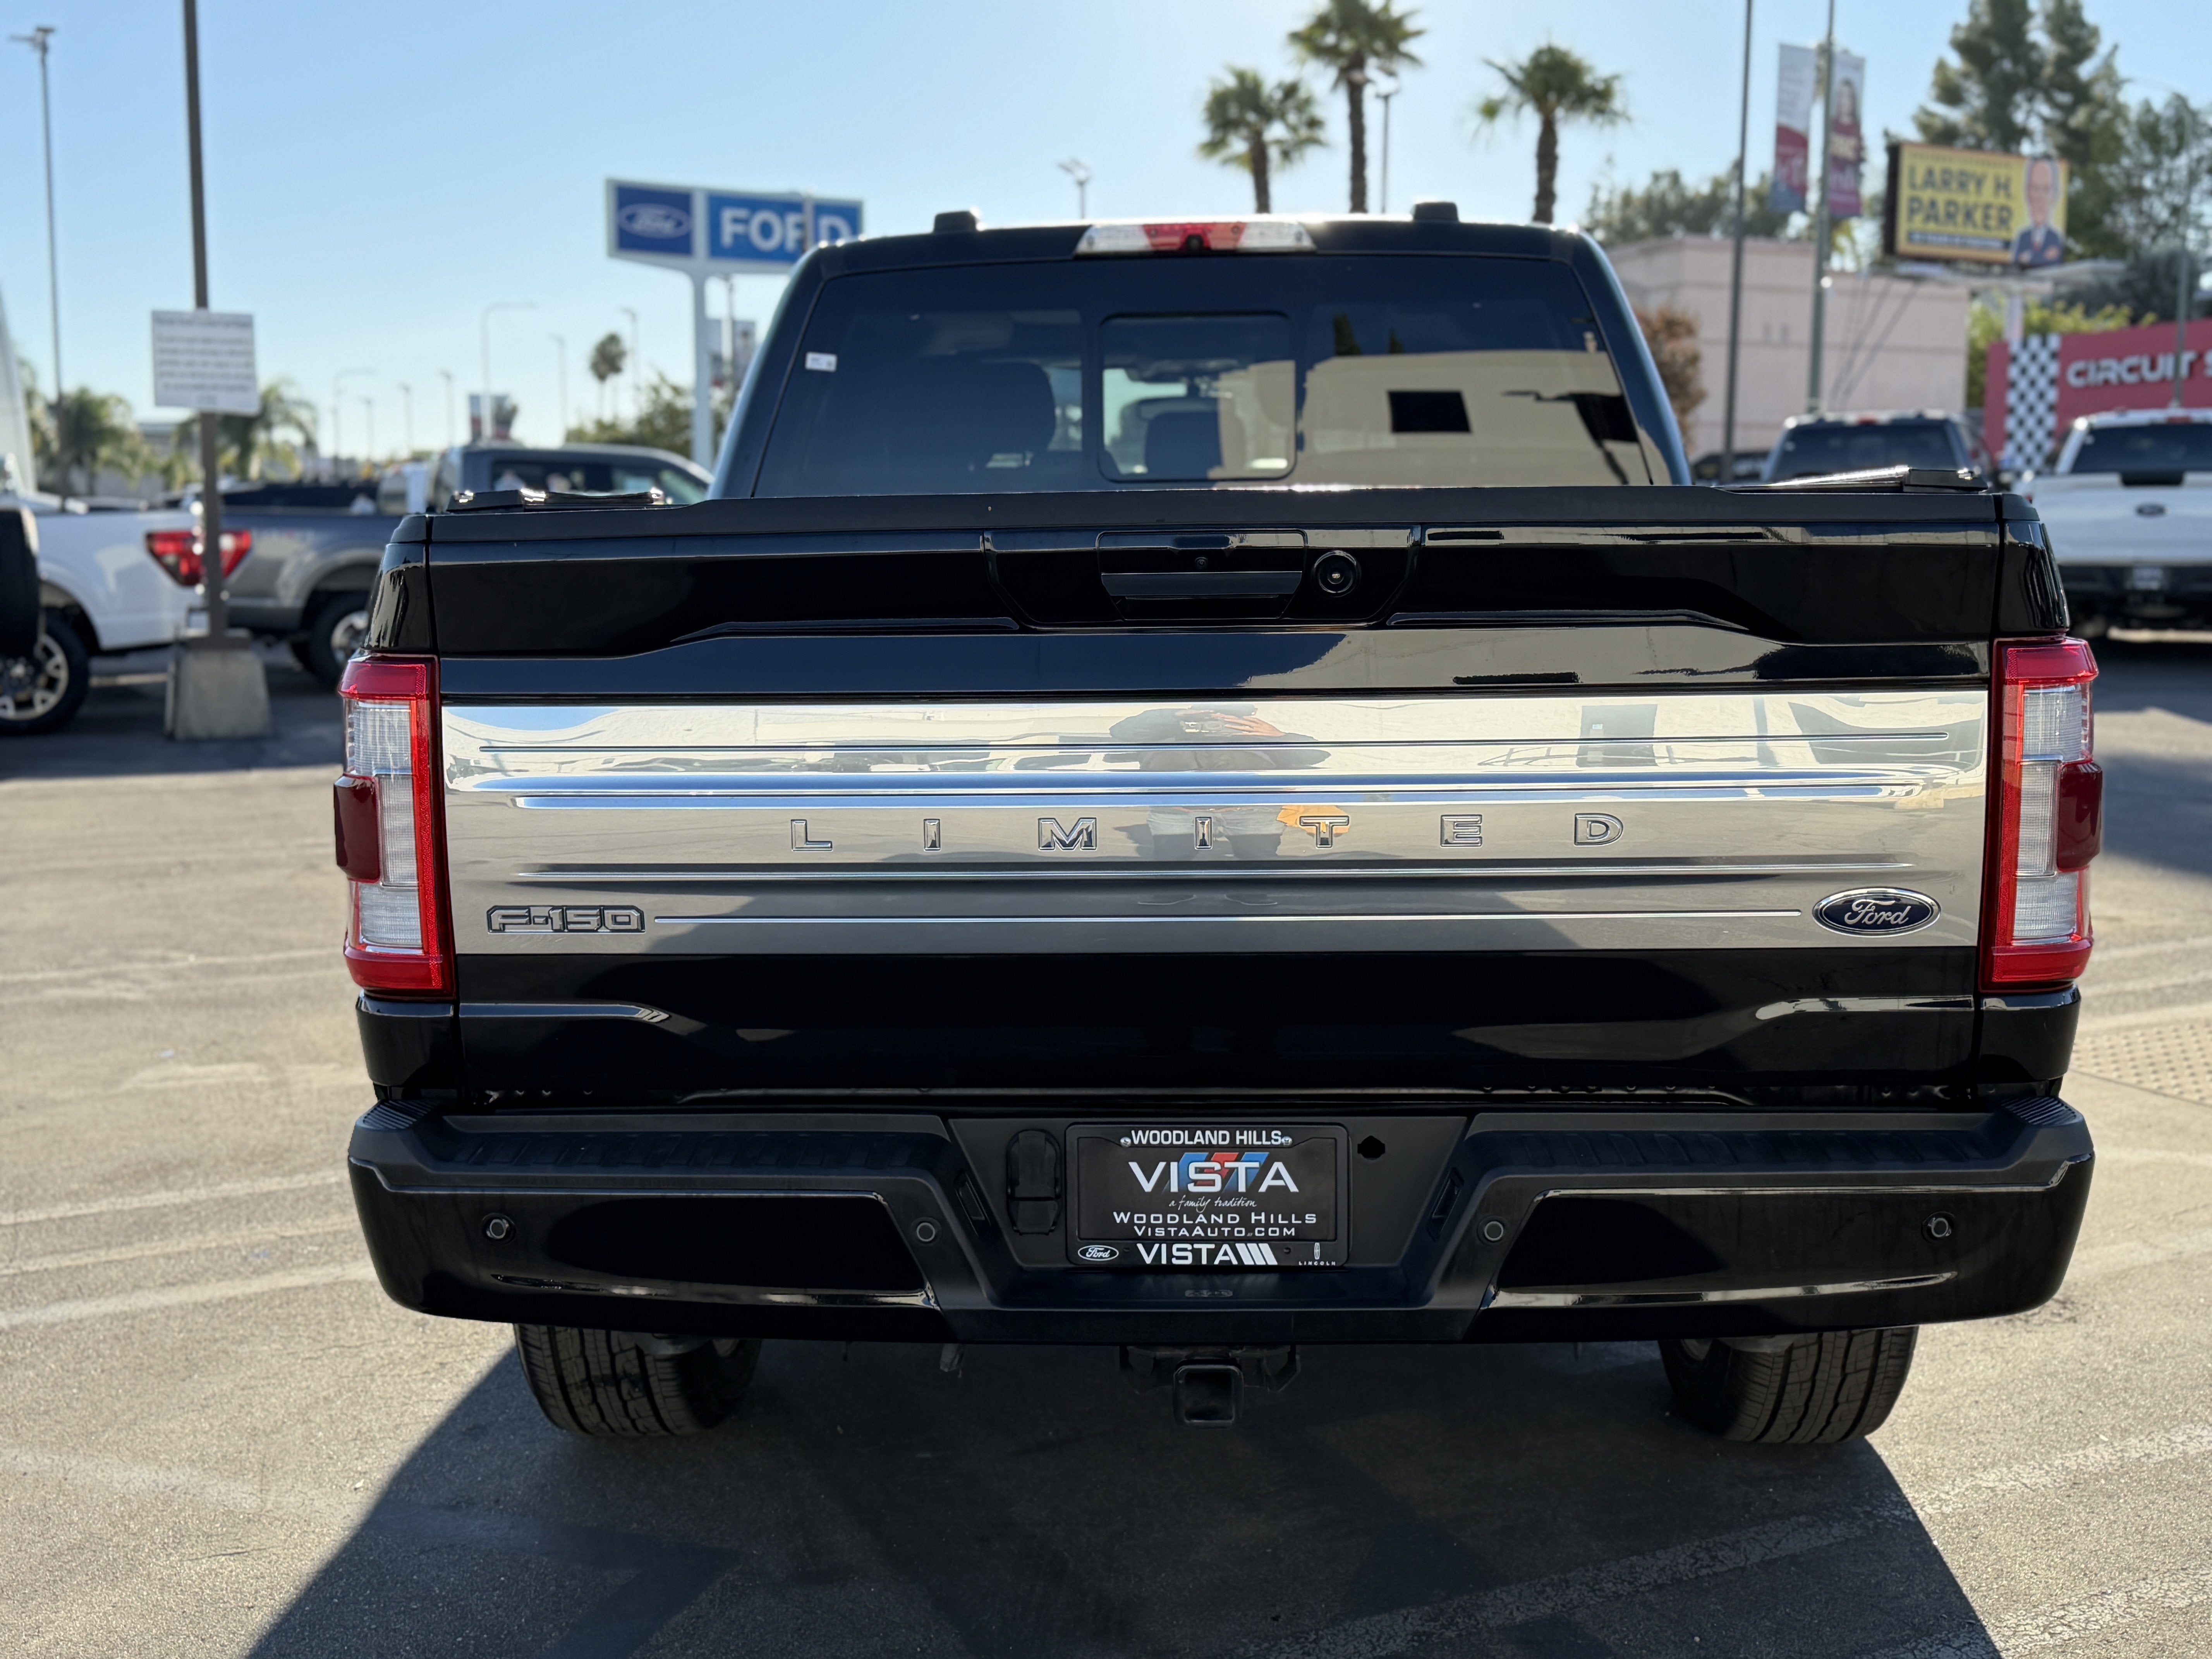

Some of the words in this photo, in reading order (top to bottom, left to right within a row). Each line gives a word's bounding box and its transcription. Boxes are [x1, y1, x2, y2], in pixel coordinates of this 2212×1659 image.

[1908, 166, 1987, 196] LARRY
[1908, 196, 2013, 231] PARKER
[2066, 349, 2198, 388] CIRCUIT
[791, 813, 1623, 851] LIMITED
[486, 905, 646, 934] F-150
[1844, 899, 1911, 925] Ford
[1131, 1130, 1230, 1145] WOODLAND
[1235, 1130, 1282, 1145] HILLS
[1128, 1161, 1299, 1193] VISTA
[1178, 1194, 1211, 1213] family
[1214, 1196, 1257, 1207] tradition
[1113, 1212, 1240, 1224] WOODLAND
[1250, 1212, 1317, 1224] HILLS
[1086, 1247, 1111, 1258] Ford
[1136, 1243, 1238, 1265] VISTA
